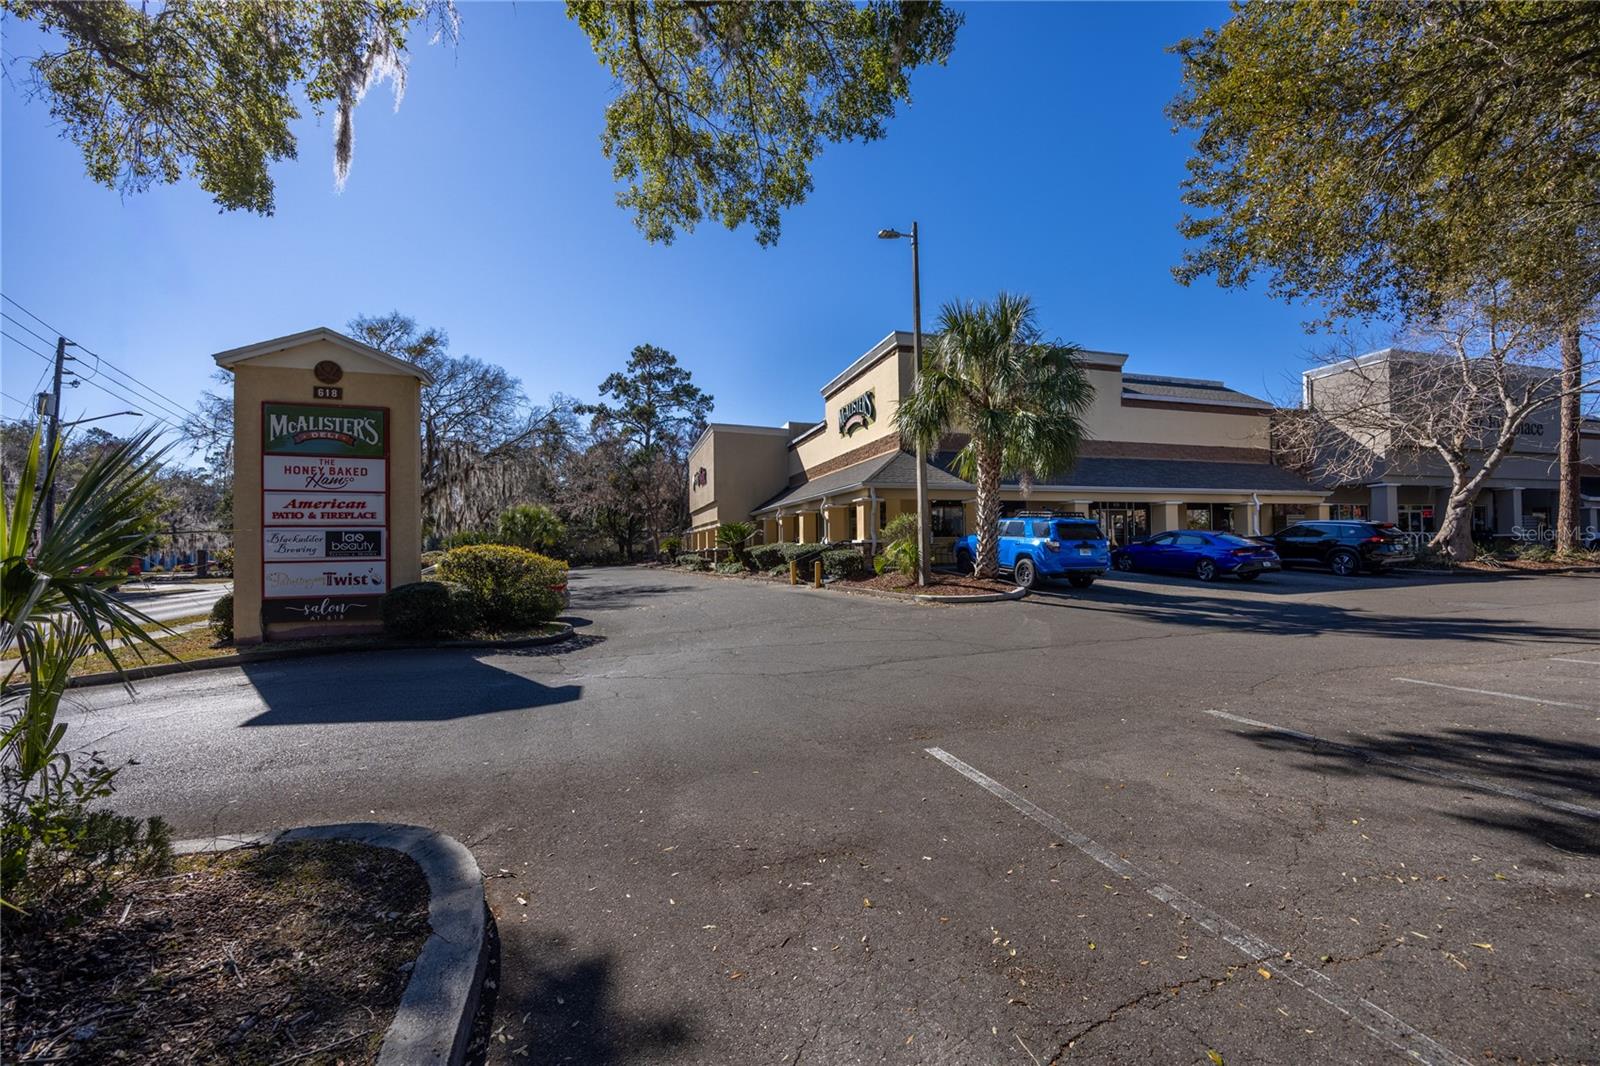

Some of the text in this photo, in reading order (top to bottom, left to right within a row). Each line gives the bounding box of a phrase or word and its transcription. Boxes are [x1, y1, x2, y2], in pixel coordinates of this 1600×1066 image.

[317, 388, 338, 397] 618
[284, 465, 368, 477] HONEY BAKED
[305, 472, 348, 490] Ham
[282, 499, 367, 509] American
[272, 512, 377, 520] PATIO & FIREPLACE
[274, 544, 318, 555] Brewing
[331, 541, 374, 551] beauty
[322, 572, 369, 586] Twist
[302, 598, 352, 616] salon
